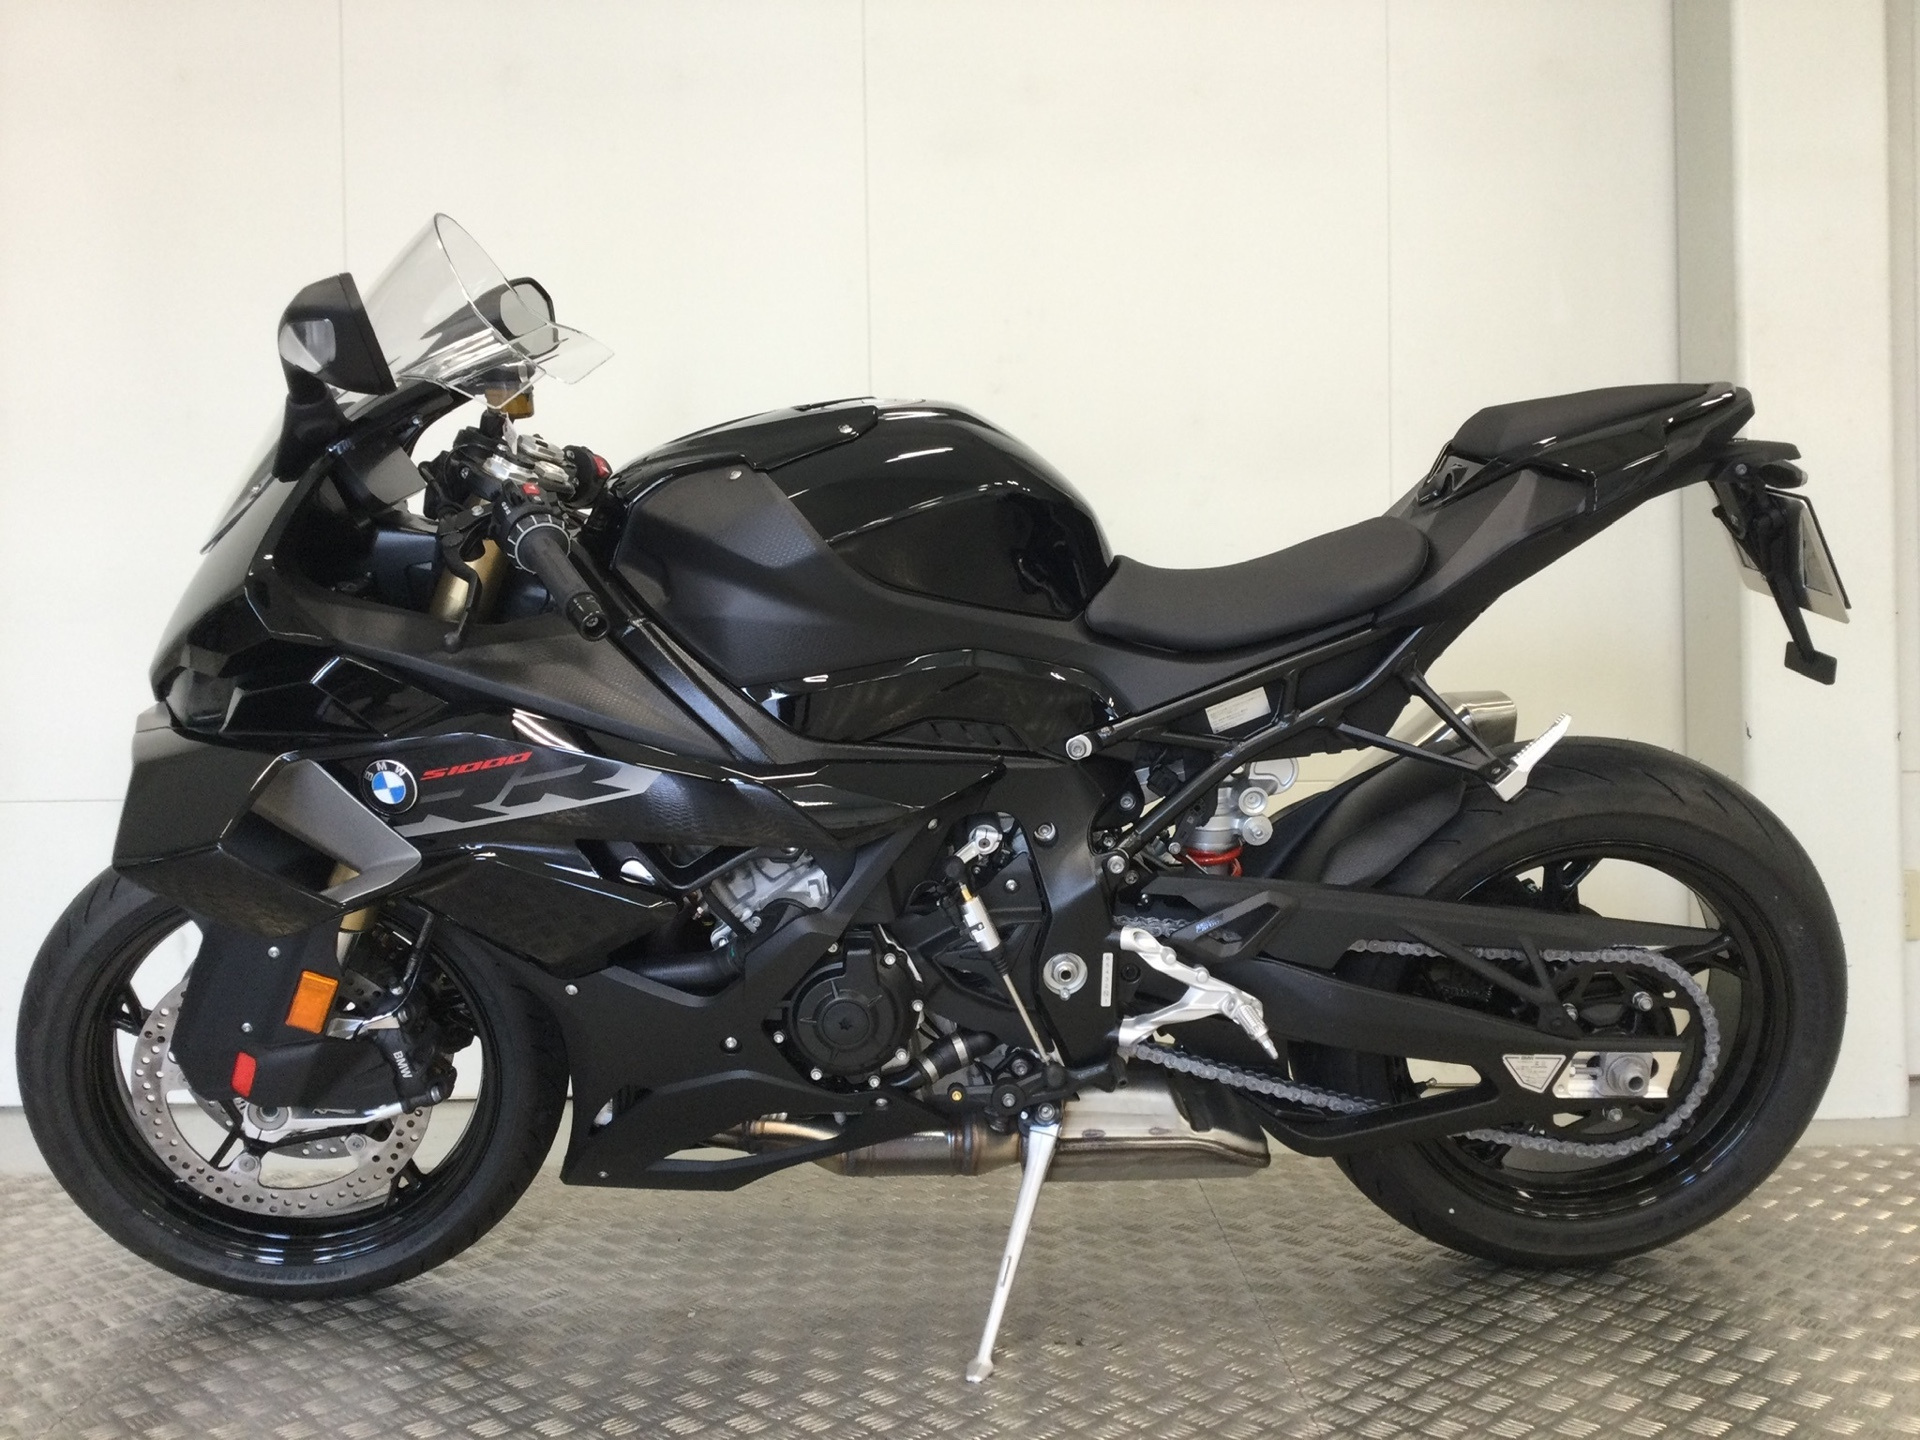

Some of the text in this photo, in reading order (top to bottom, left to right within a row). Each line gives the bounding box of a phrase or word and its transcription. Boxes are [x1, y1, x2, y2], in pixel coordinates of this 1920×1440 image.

[363, 761, 407, 781] BMW
[420, 751, 533, 781] S1000
[393, 1050, 413, 1078] BMW
